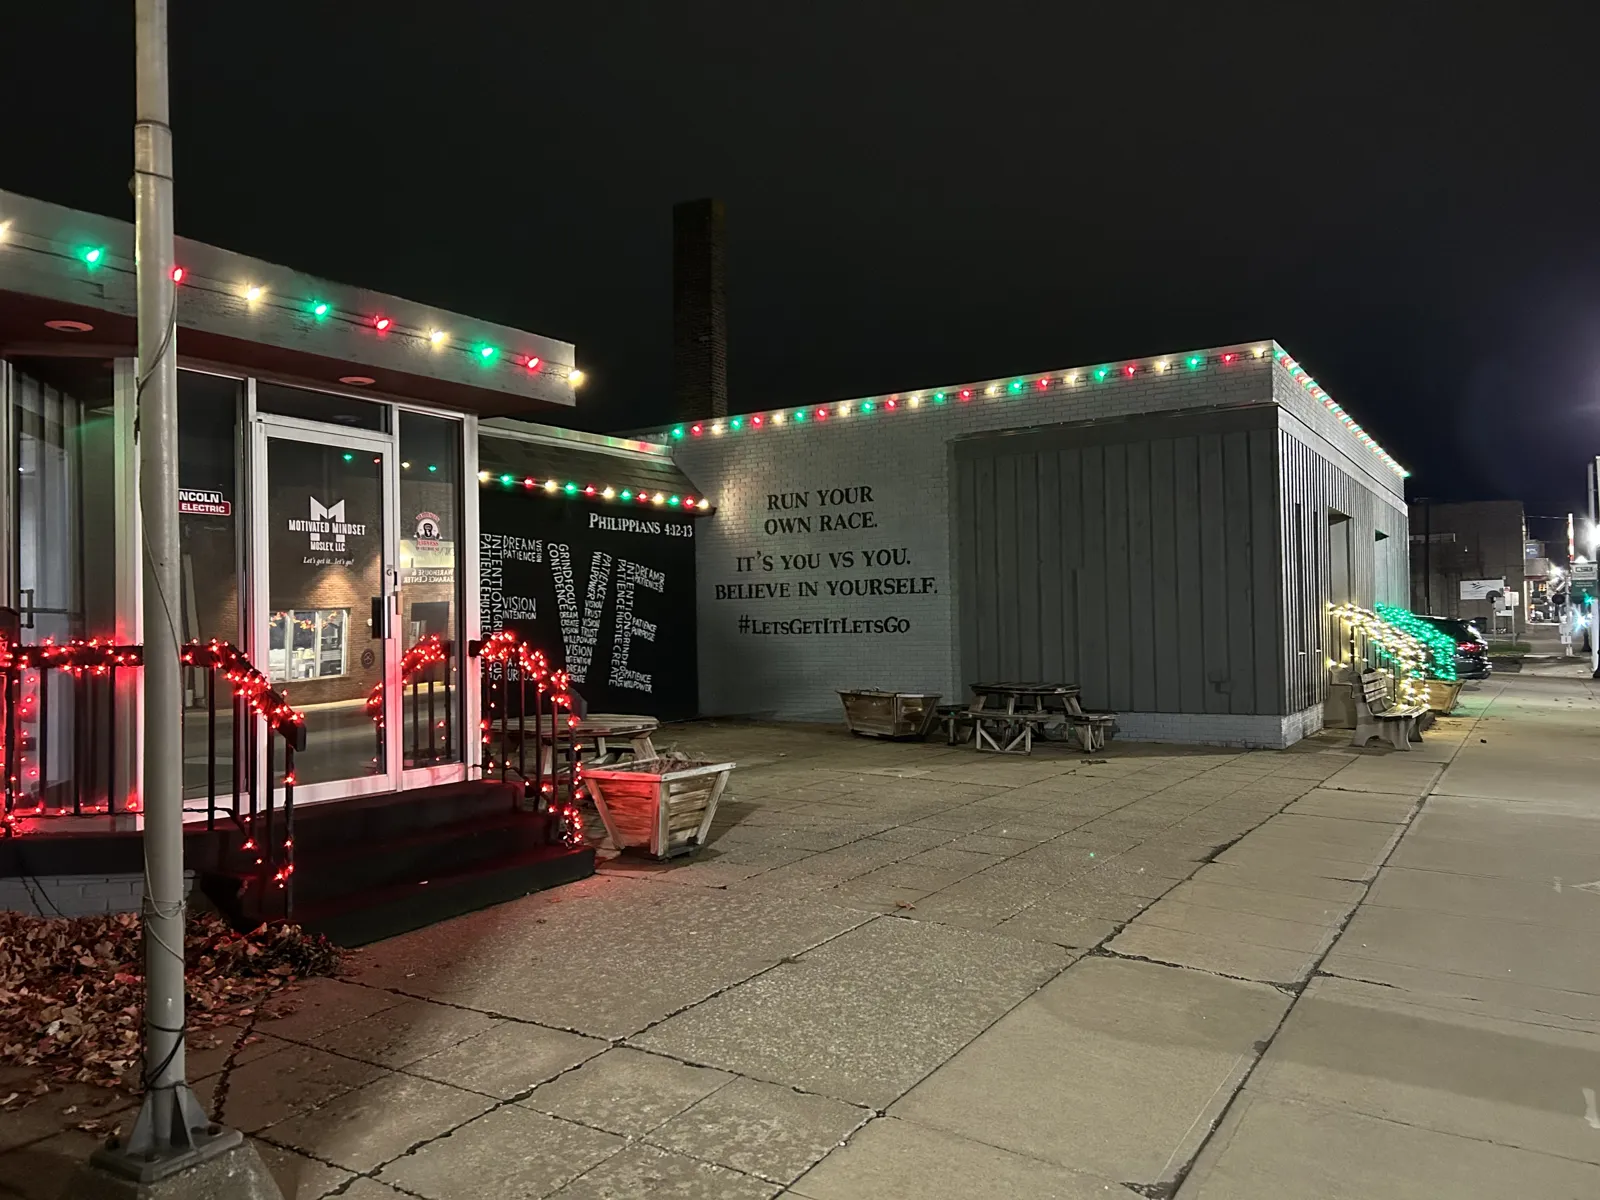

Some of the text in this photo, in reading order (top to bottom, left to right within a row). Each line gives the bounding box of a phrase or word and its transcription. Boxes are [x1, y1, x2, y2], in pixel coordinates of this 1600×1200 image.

[179, 491, 219, 503] NCOLN
[181, 503, 225, 513] ELECTRIC
[767, 485, 874, 510] RUN YOUR
[288, 519, 366, 536] MOTIVATED MINDSET
[589, 512, 660, 534] PHILIPPIANS
[764, 511, 878, 535] OWN RACE.
[335, 542, 346, 552] LLC
[503, 535, 536, 551] DREAM
[480, 533, 492, 593] PATIENCE
[503, 549, 536, 563] PATIENCE
[736, 548, 911, 572] IT'S YOU VS YOU.
[491, 534, 503, 613] INTENTION
[547, 543, 568, 610] CONFIDENCE
[558, 544, 577, 610] GRIND FOCUS
[586, 551, 602, 600] WILLPOWER
[597, 553, 612, 600] PATIENCE
[715, 577, 938, 600] BELIEVE IN YOURSELF.
[480, 593, 492, 631] HUSTLE
[502, 596, 536, 612] VISION
[502, 609, 536, 620] INTENTION
[584, 607, 602, 619] TRUST
[581, 626, 599, 637] TRUST
[608, 558, 627, 687] PATIENCE HUSTLE CREATE
[617, 562, 635, 687] INTENTION GRIND FOCUS
[563, 635, 598, 645] WILLPOWER
[565, 644, 593, 657] VISION
[566, 664, 588, 674] DREAM
